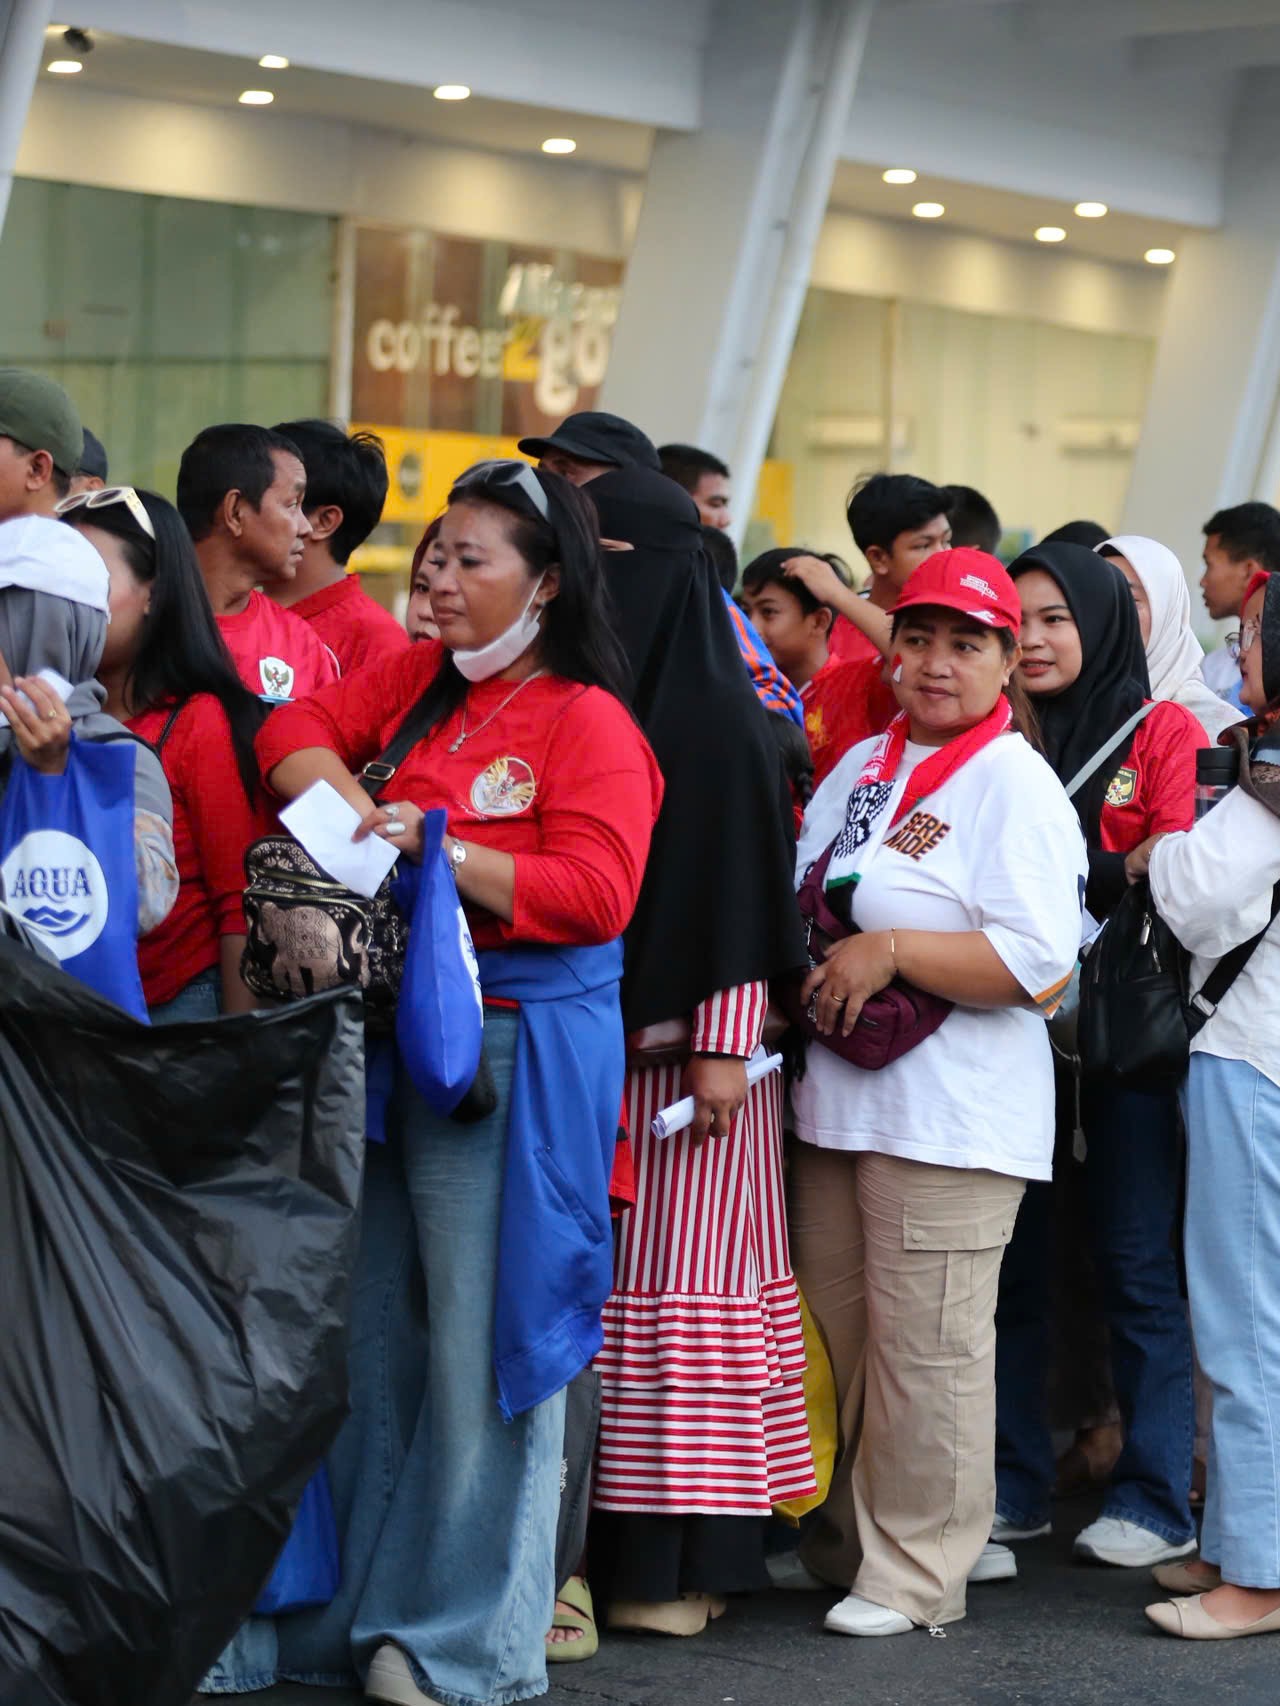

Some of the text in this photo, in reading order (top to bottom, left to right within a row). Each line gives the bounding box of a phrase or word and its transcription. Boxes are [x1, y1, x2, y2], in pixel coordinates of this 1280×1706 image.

[882, 829, 935, 862] NADE
[902, 811, 952, 847] SERE
[10, 867, 92, 903] AQUA
